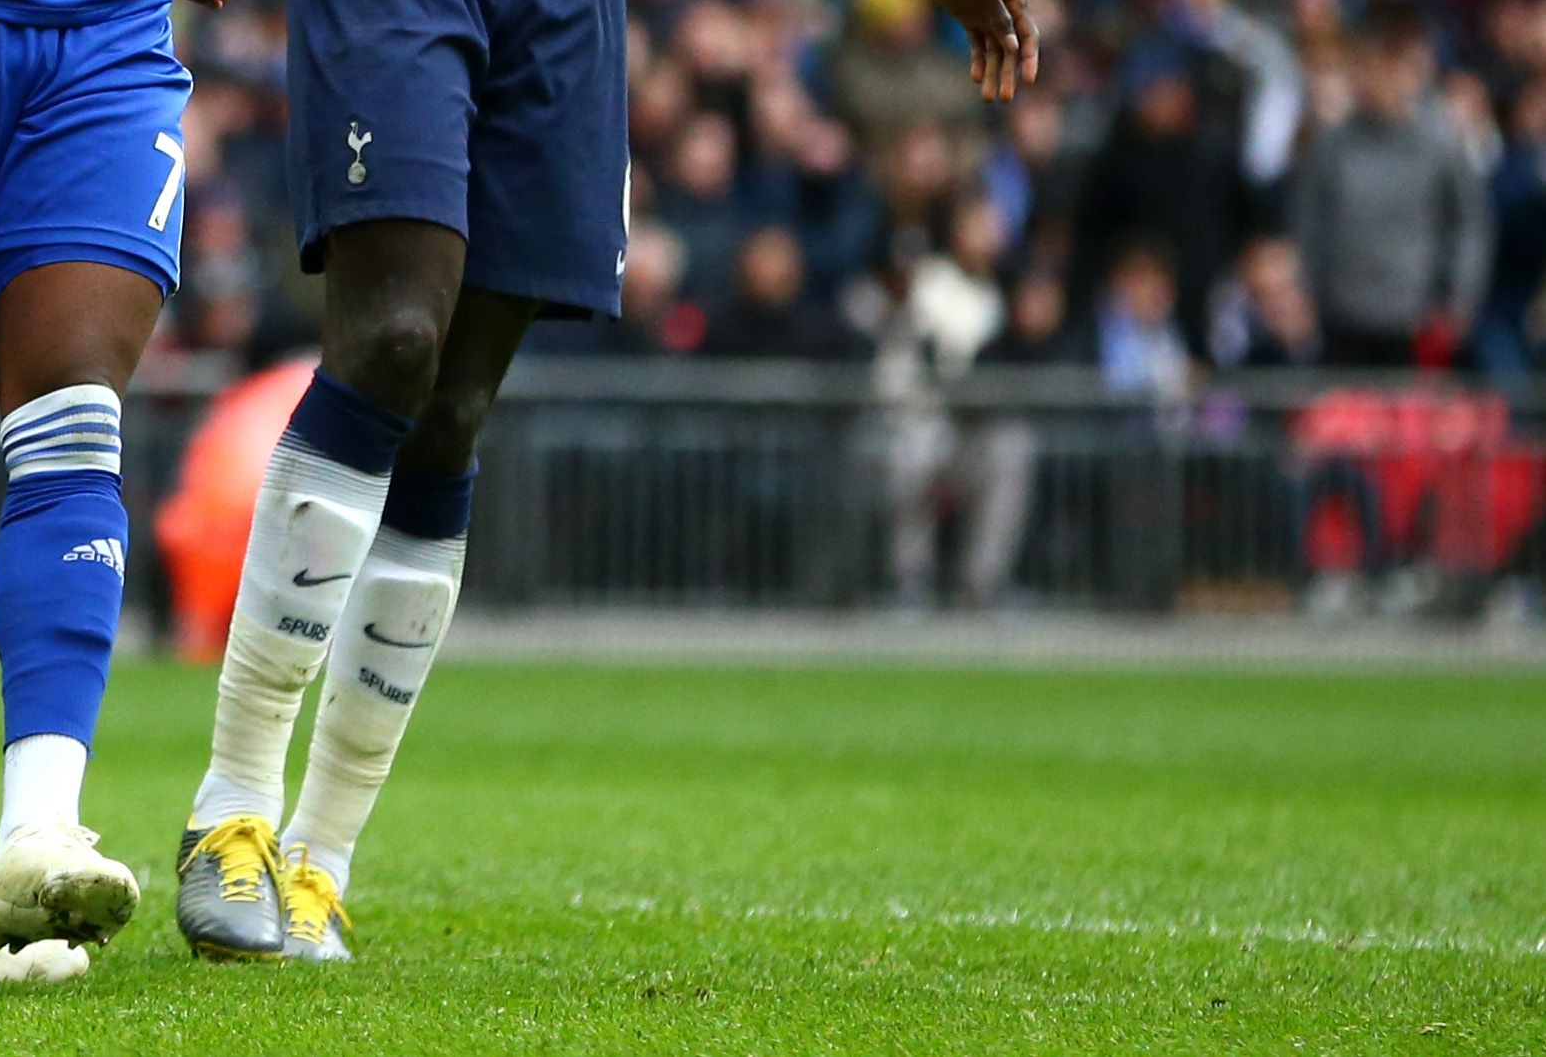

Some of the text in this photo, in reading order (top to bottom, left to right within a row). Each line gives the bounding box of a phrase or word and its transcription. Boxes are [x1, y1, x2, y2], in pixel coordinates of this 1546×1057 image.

[147, 130, 184, 232] 7
[63, 551, 125, 581] adida
[276, 617, 330, 642] SPURS
[358, 667, 413, 705] SPURS
